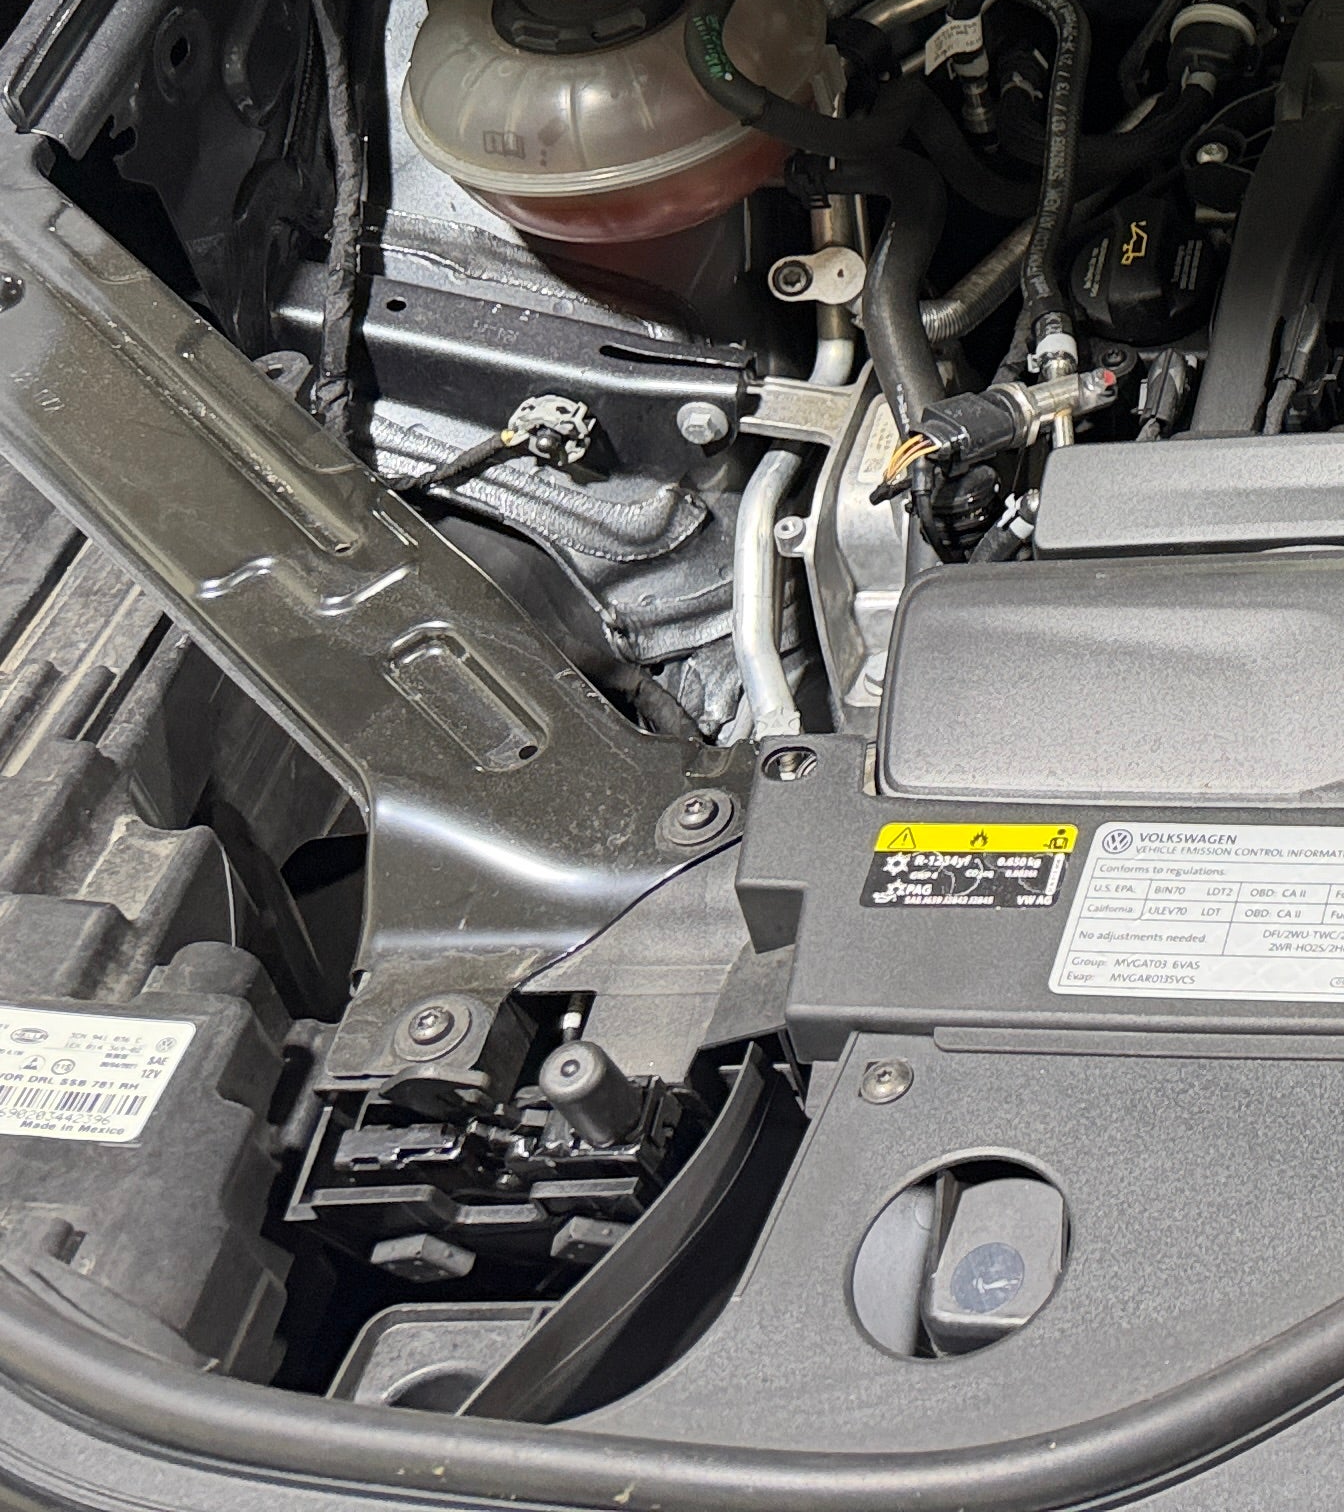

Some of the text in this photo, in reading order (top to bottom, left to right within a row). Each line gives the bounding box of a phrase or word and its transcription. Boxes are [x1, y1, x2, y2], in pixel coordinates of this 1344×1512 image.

[1139, 832, 1238, 846] VOLKSWAGEN
[1136, 846, 1178, 855] VEHICLE
[1181, 846, 1231, 856] EMISSION
[1234, 848, 1283, 858] CONTROL
[1100, 863, 1149, 874] Conforms
[1152, 865, 1164, 874] to
[906, 884, 932, 894] PAG
[1154, 886, 1186, 895] BIN70
[1206, 887, 1233, 897] LDT2
[1282, 889, 1297, 898] CA
[1017, 895, 1037, 905] VW
[1201, 908, 1222, 917] LDT
[1276, 910, 1292, 918] CA
[1079, 930, 1094, 940] No
[1096, 931, 1164, 943] adjustments
[147, 1056, 169, 1066] SAE
[141, 1069, 162, 1079] 12V
[20, 1120, 125, 1135] Made in Mexico
